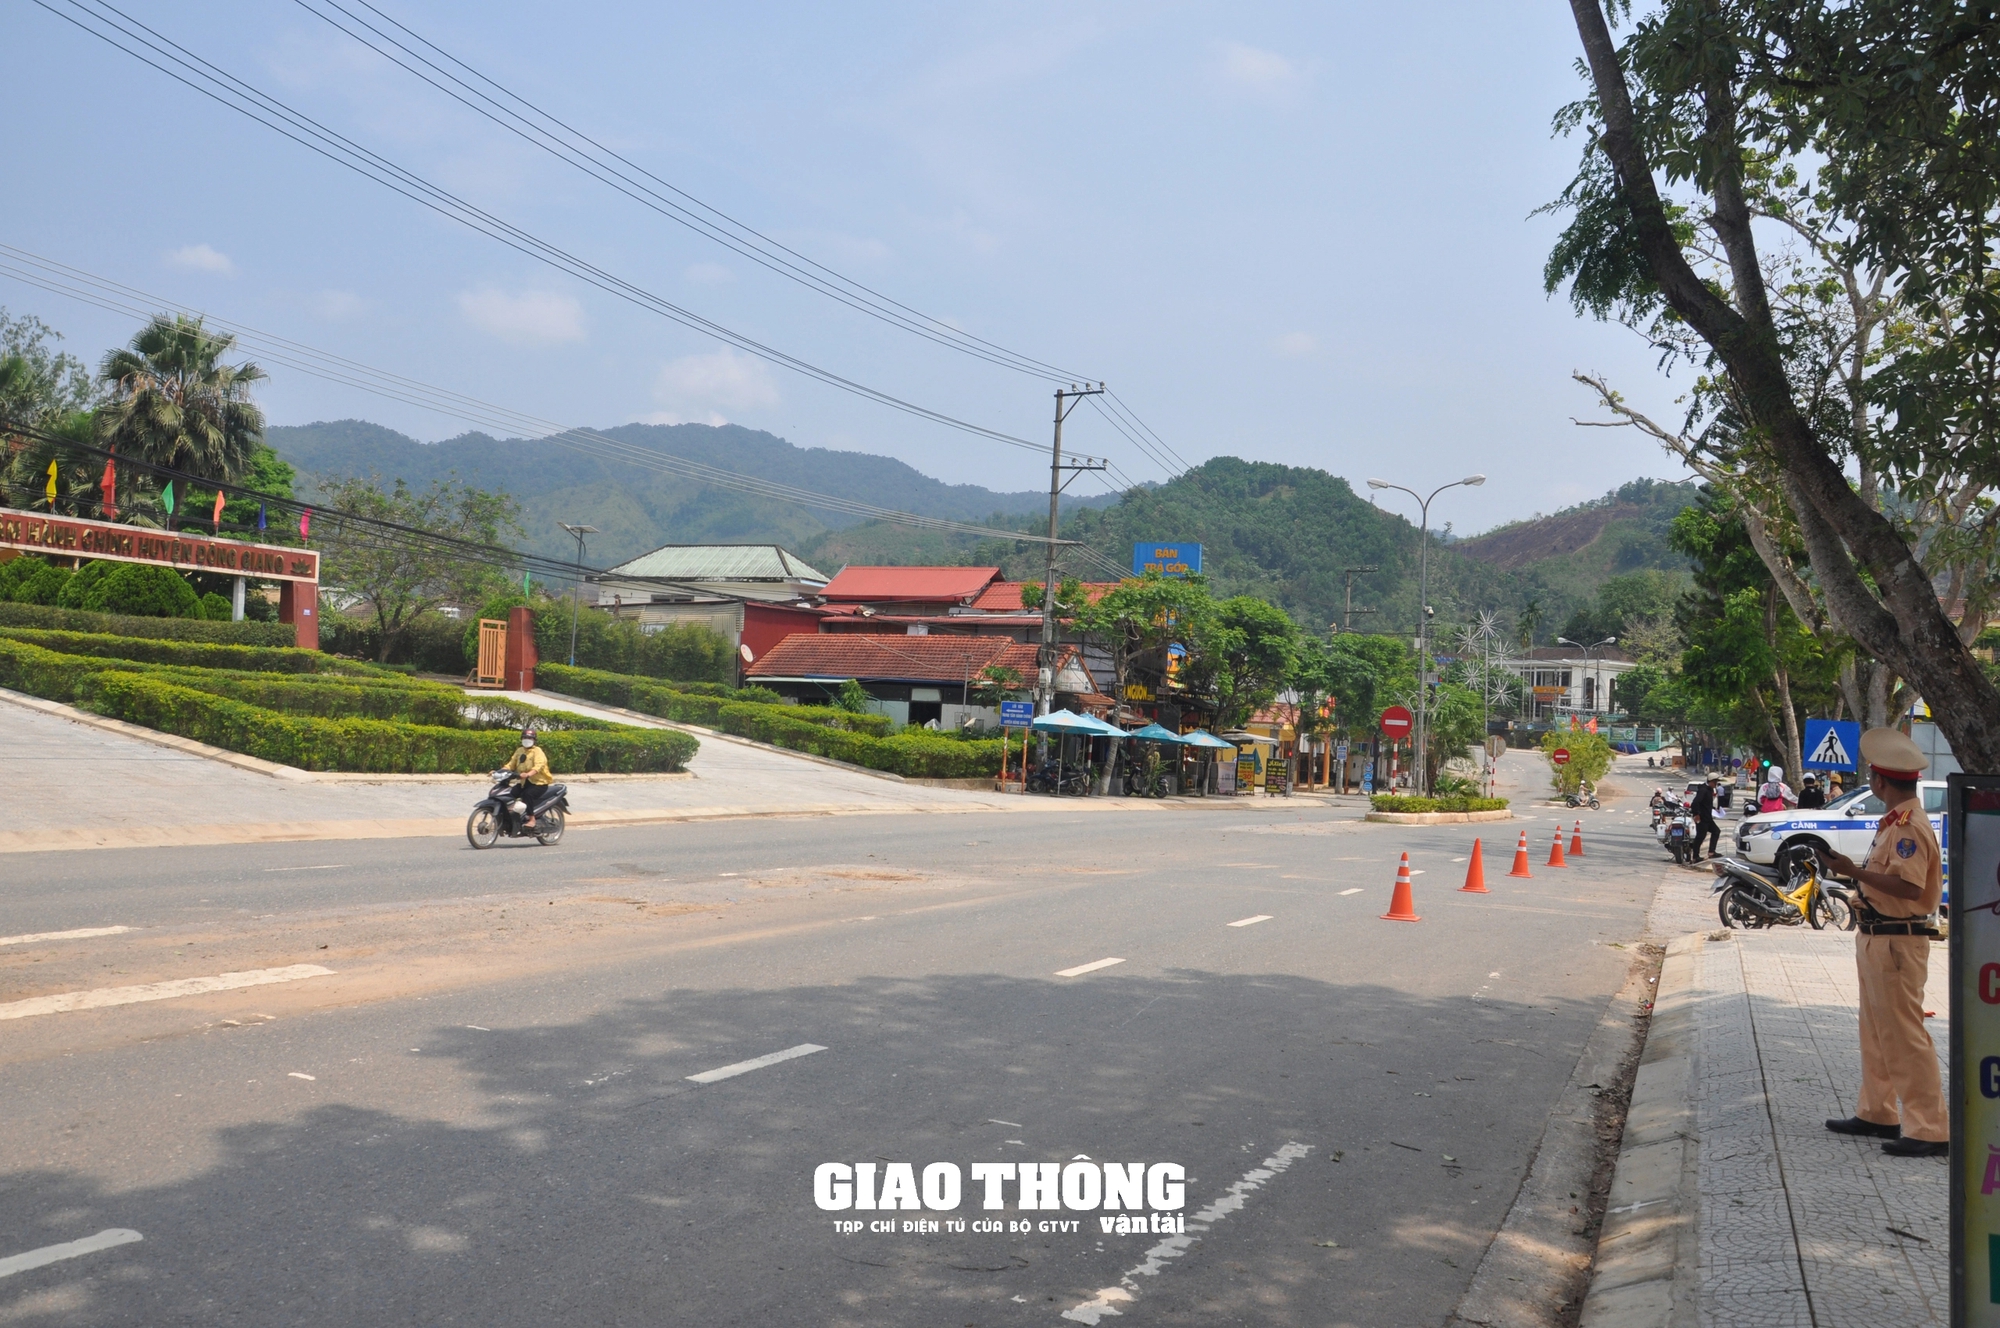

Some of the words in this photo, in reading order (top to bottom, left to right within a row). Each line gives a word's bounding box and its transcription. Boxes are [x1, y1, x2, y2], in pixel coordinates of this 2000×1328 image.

[27, 519, 77, 547] HÀNH
[82, 528, 133, 554] CHÍNH
[138, 537, 192, 564] HUYỆN
[196, 542, 237, 567] ĐÔNG
[241, 550, 285, 573] GIANG
[1155, 547, 1178, 558] BÁN
[1144, 560, 1165, 573] TRẢ
[1165, 560, 1188, 573] GÓP
[1791, 820, 1817, 830] CẢNH
